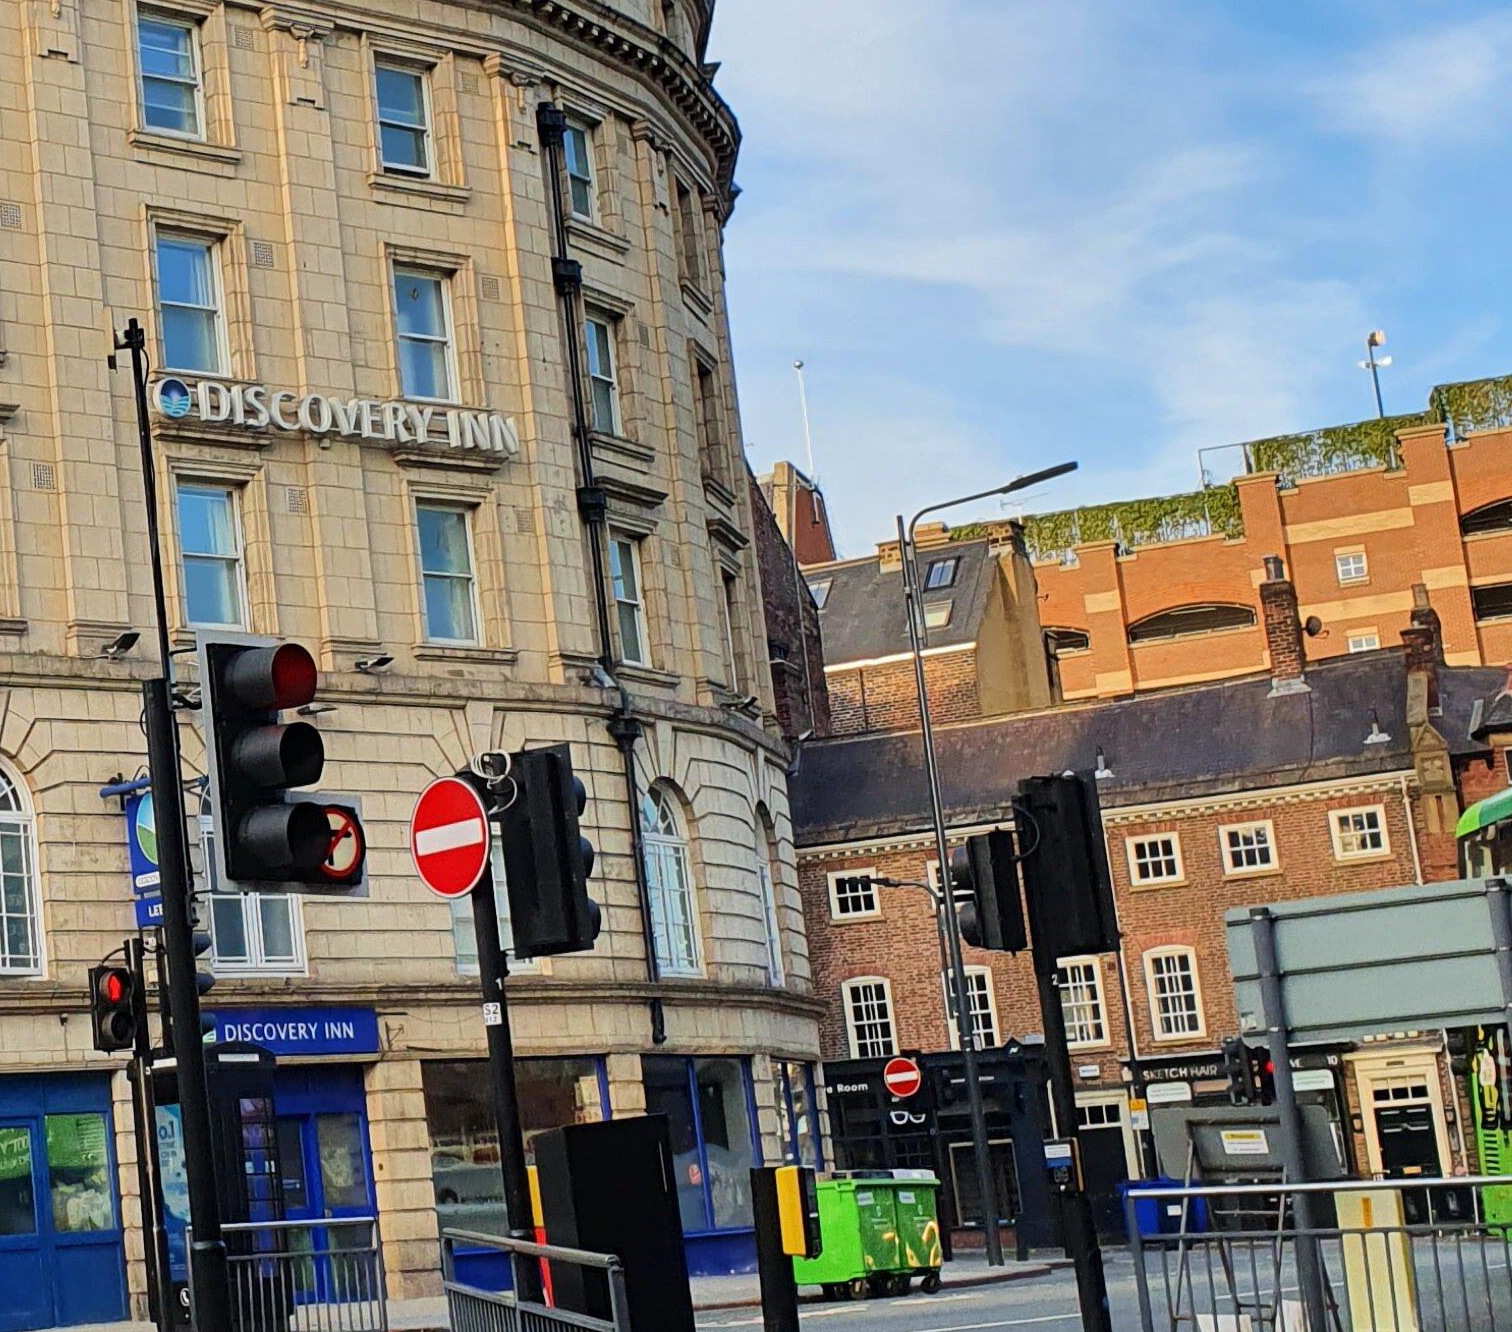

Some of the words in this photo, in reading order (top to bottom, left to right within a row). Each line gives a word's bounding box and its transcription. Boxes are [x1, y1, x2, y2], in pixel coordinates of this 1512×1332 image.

[196, 380, 434, 445] DISCOVERY
[446, 409, 519, 455] INN
[1051, 973, 1059, 985] 2
[484, 1004, 499, 1015] S2
[224, 1022, 318, 1042] DISCOVERY
[324, 1021, 355, 1039] INN
[1142, 1067, 1187, 1080] SKETCH
[1190, 1065, 1218, 1077] HAIR
[836, 1083, 869, 1093] Room
